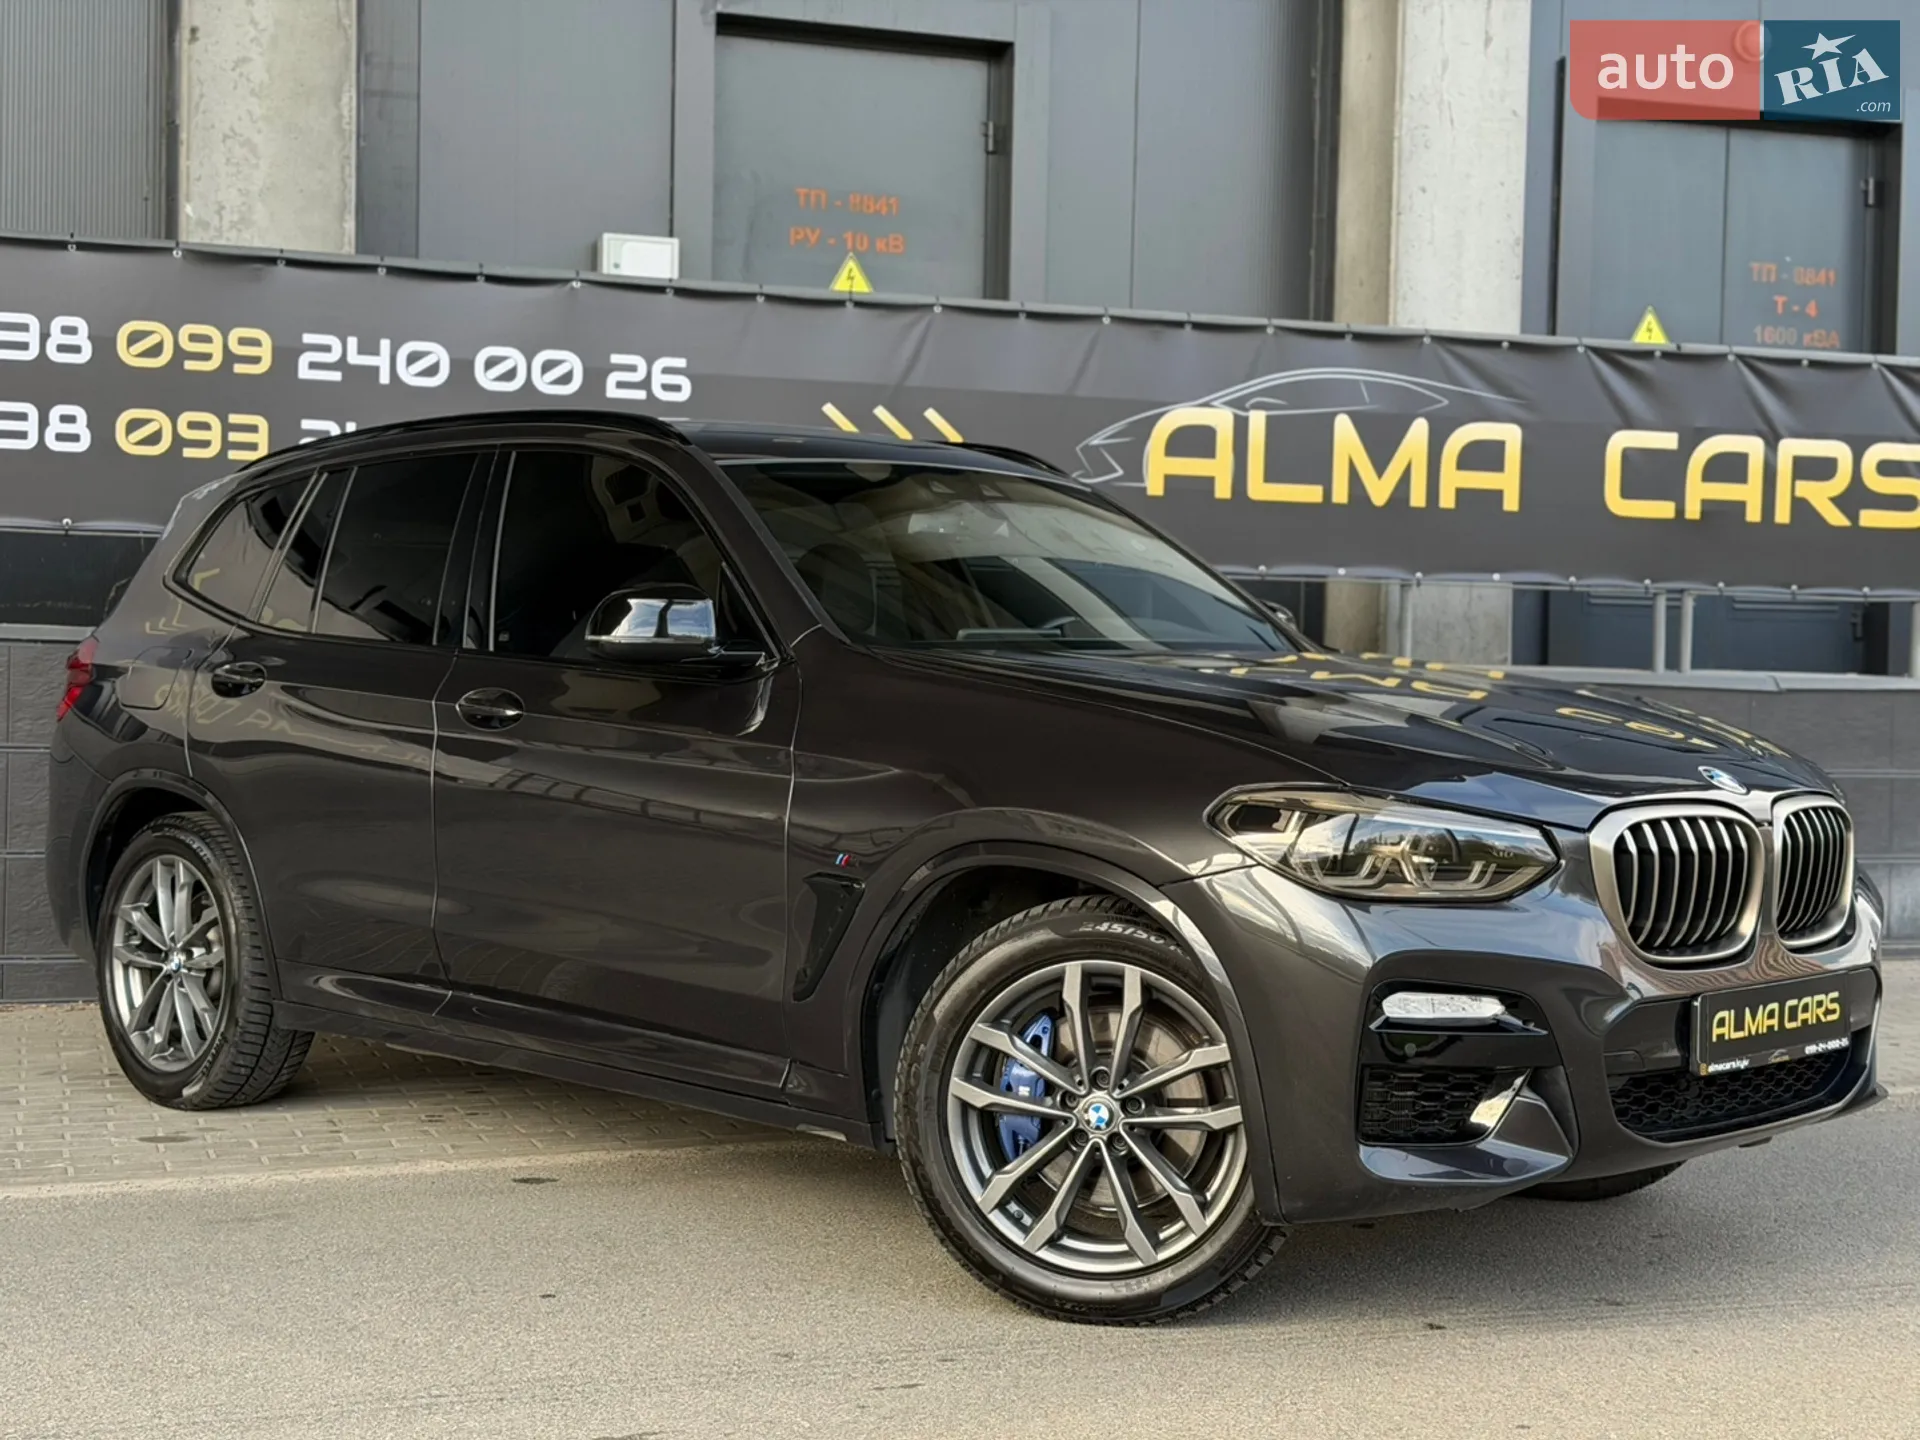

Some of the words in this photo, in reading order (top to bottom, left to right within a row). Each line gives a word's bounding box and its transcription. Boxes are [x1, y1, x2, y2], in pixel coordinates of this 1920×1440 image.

[843, 231, 871, 252] 10
[1804, 299, 1820, 320] 4
[116, 321, 273, 374] 099
[298, 333, 450, 388] 240
[474, 346, 583, 396] 00
[605, 353, 692, 402] 26
[115, 408, 269, 460] 093
[1146, 406, 1523, 513] ALMA
[1604, 429, 1920, 530] CARS
[1712, 1002, 1779, 1042] ALMA
[1784, 991, 1840, 1030] CARS
